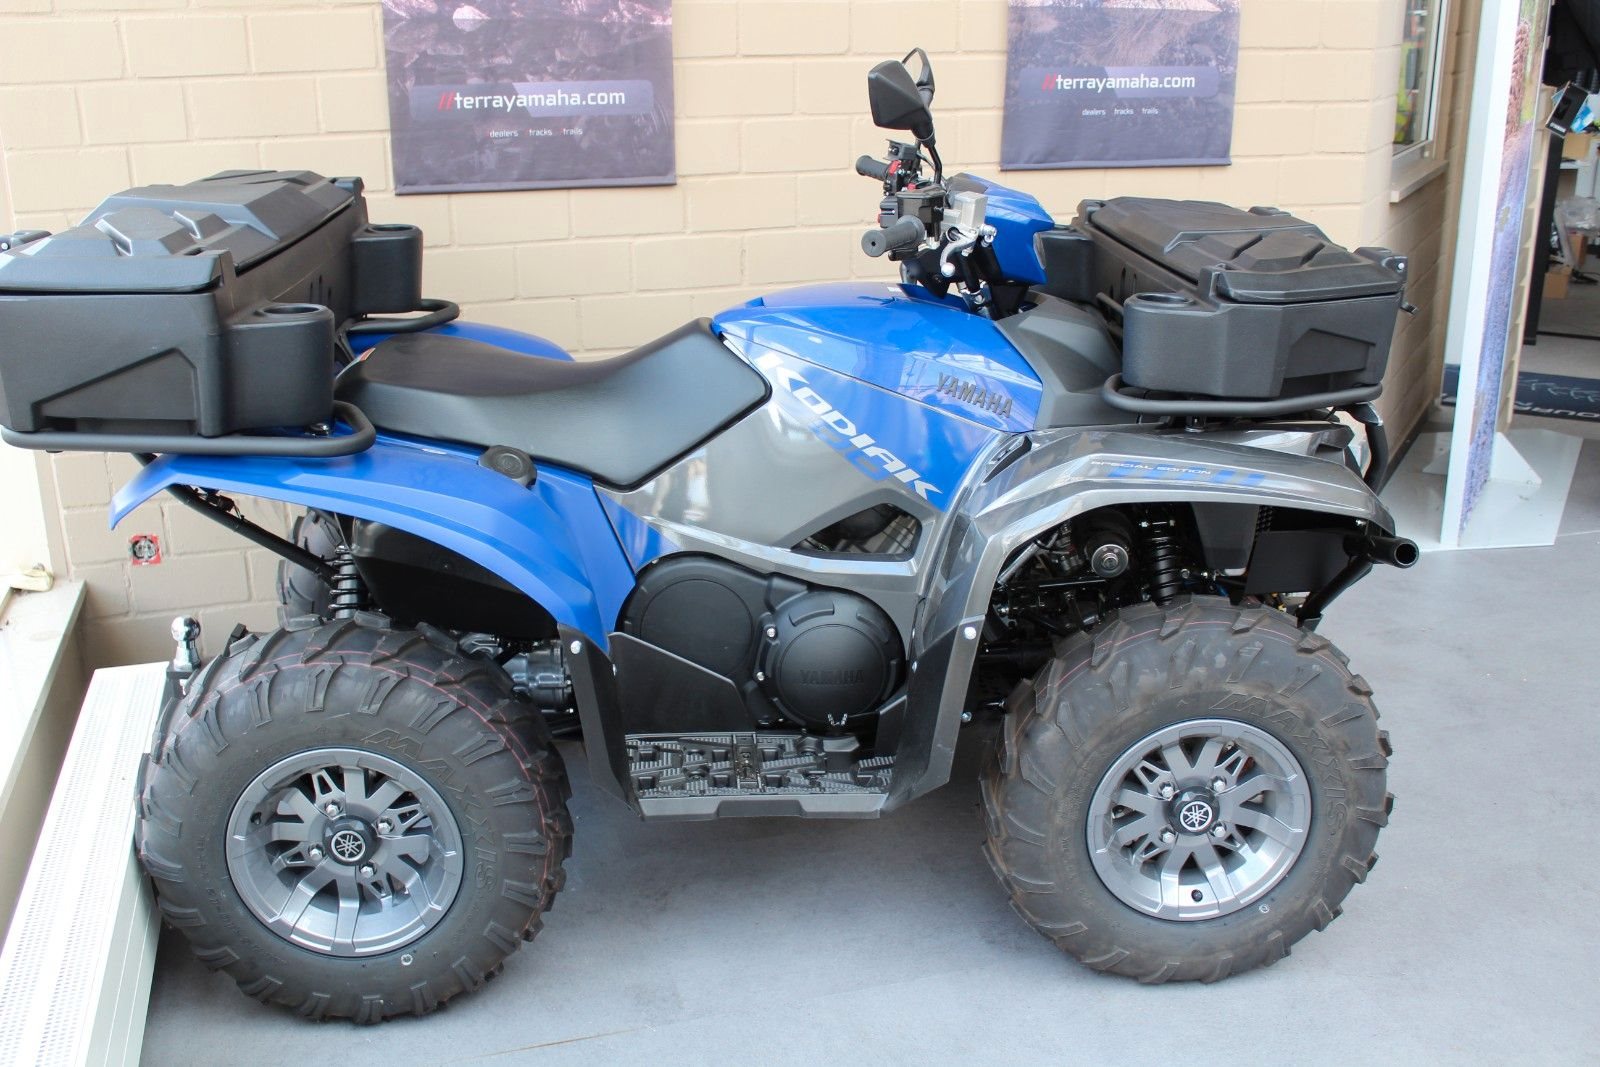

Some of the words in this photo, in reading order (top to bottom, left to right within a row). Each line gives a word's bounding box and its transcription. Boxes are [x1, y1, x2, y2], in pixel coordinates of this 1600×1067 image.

[753, 353, 943, 500] KODIAK
[937, 372, 1013, 419] YAMAHA
[1155, 465, 1212, 476] EDITION
[800, 669, 864, 686] YAMAHA
[1208, 692, 1348, 832] MAXXIS
[360, 728, 498, 892] MAXXIS
